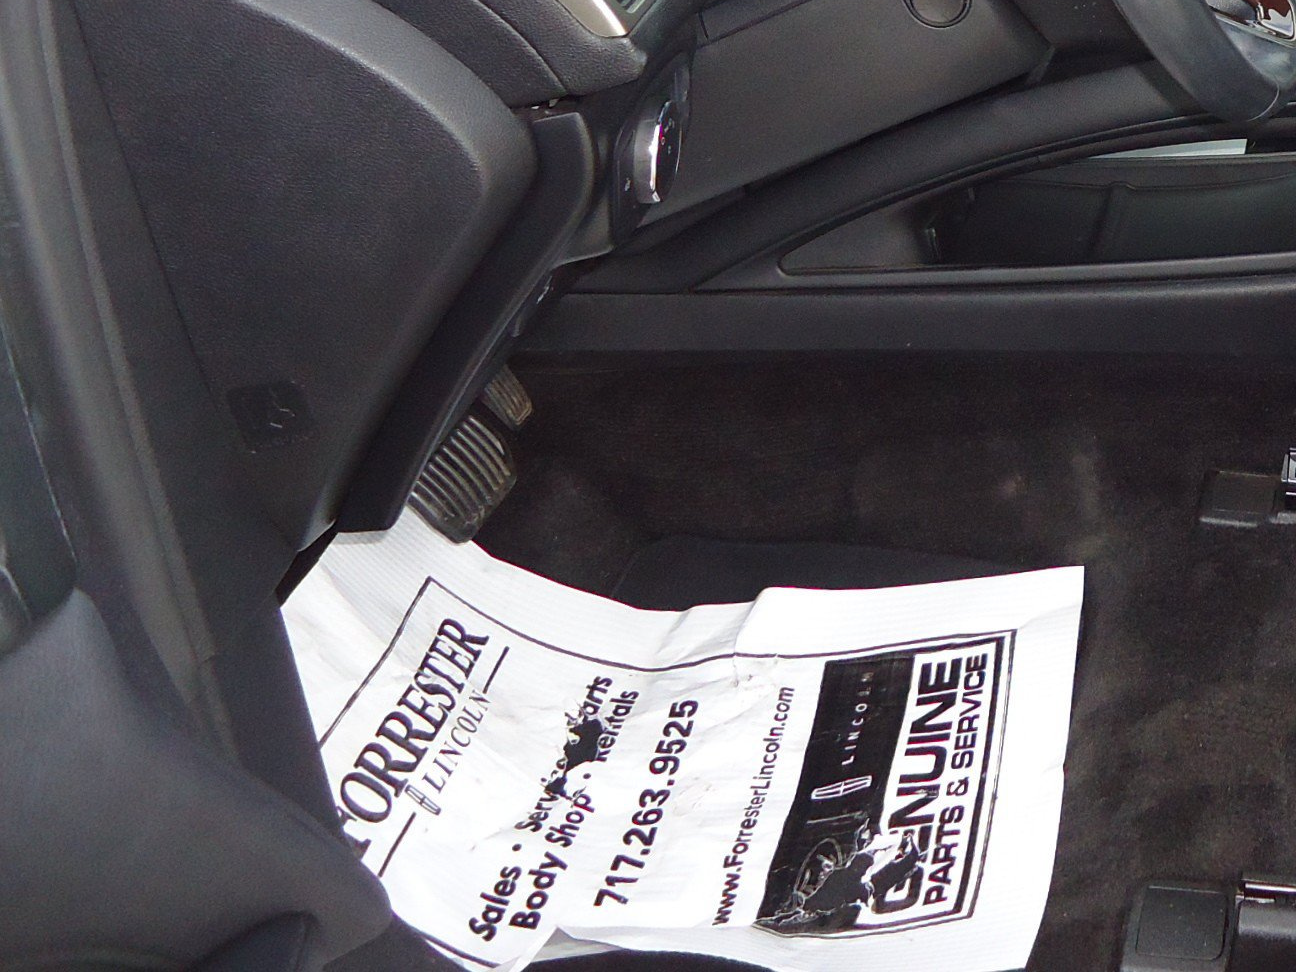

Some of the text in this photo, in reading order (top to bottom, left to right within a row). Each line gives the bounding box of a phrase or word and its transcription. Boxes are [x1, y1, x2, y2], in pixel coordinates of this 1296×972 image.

[421, 689, 491, 795] LINCOLN
[593, 699, 699, 908] 717.263.9525
[712, 686, 796, 926] www.ForresterLincoln.com
[922, 652, 989, 906] PARTS & SERVICE
[468, 865, 522, 942] Sales
[510, 850, 569, 931] Body
[544, 792, 596, 848] Shop
